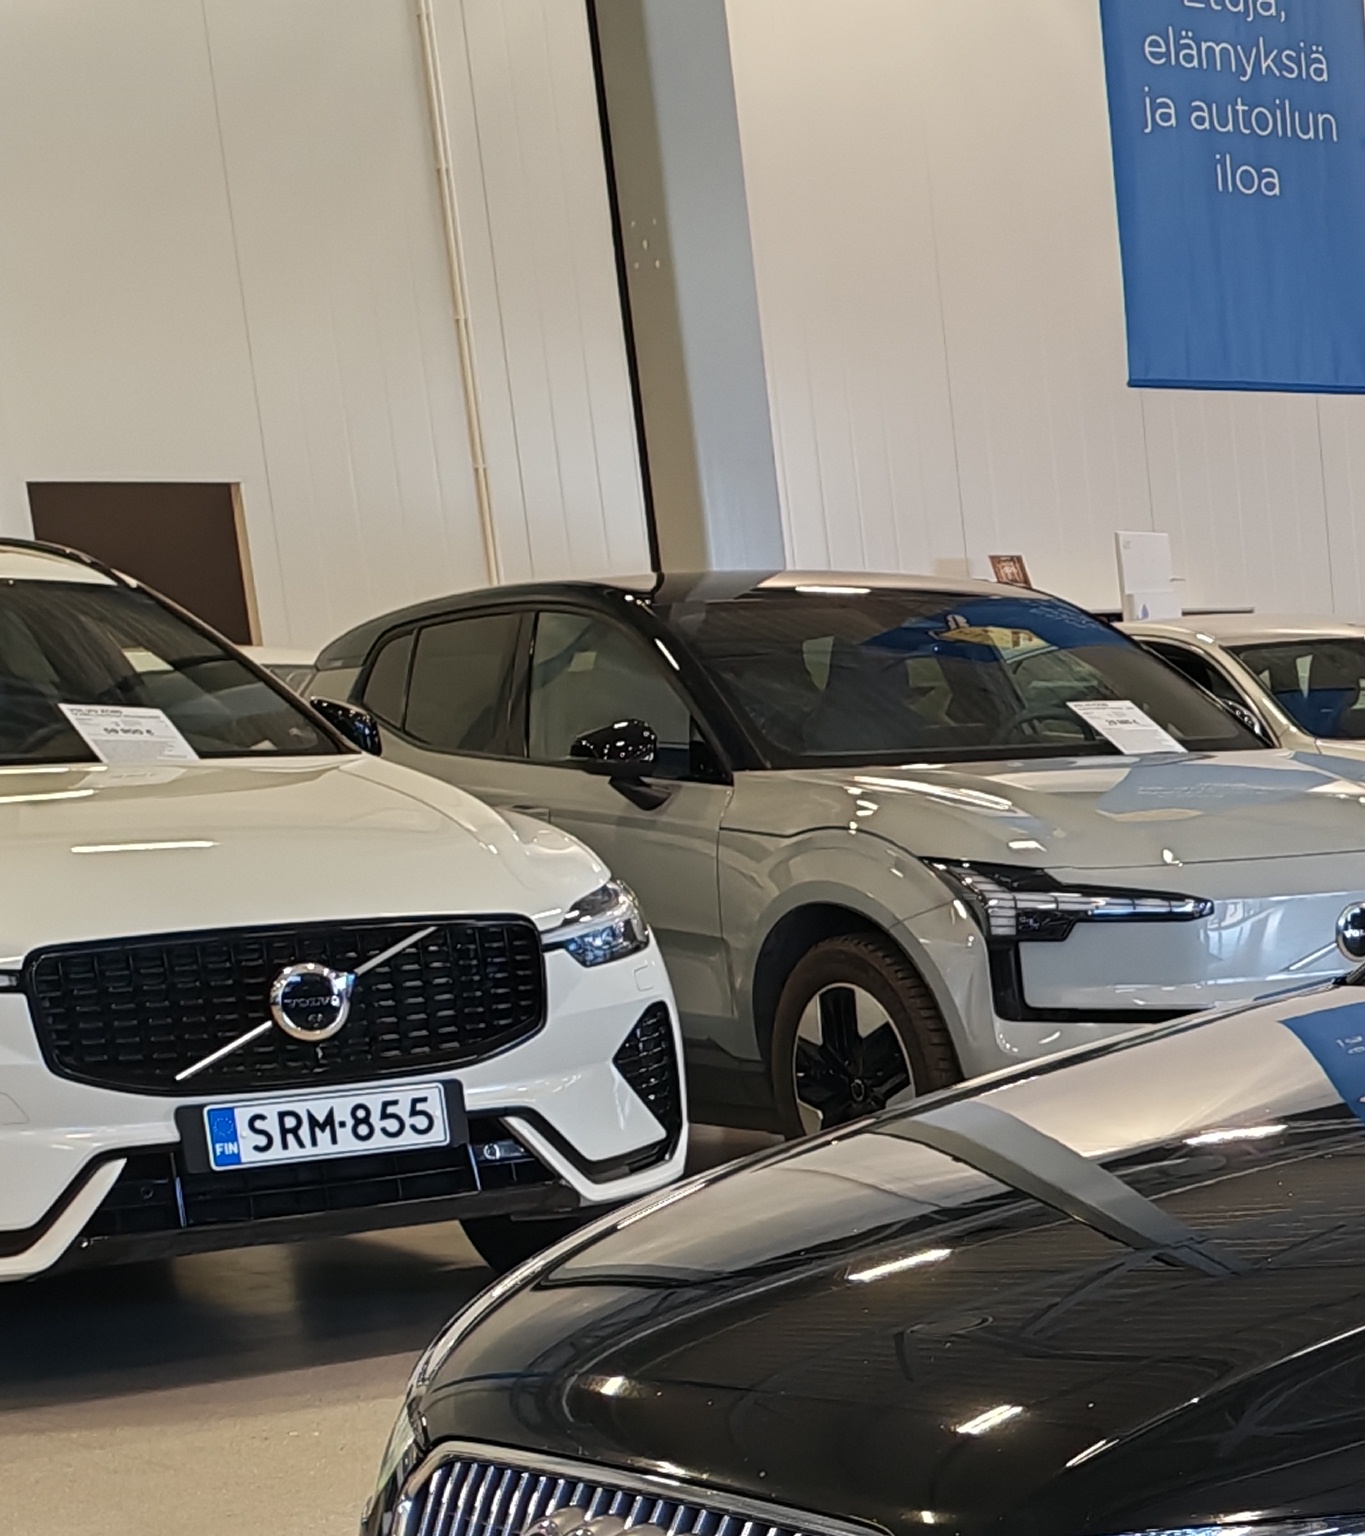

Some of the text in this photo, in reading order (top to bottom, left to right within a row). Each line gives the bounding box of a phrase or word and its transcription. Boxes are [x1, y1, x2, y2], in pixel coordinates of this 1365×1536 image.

[1144, 26, 1328, 82] elämyksiä
[1143, 86, 1338, 142] ja autoilun
[1215, 153, 1280, 196] iloa
[215, 1142, 238, 1156] FIN
[248, 1096, 435, 1153] SRM-855
